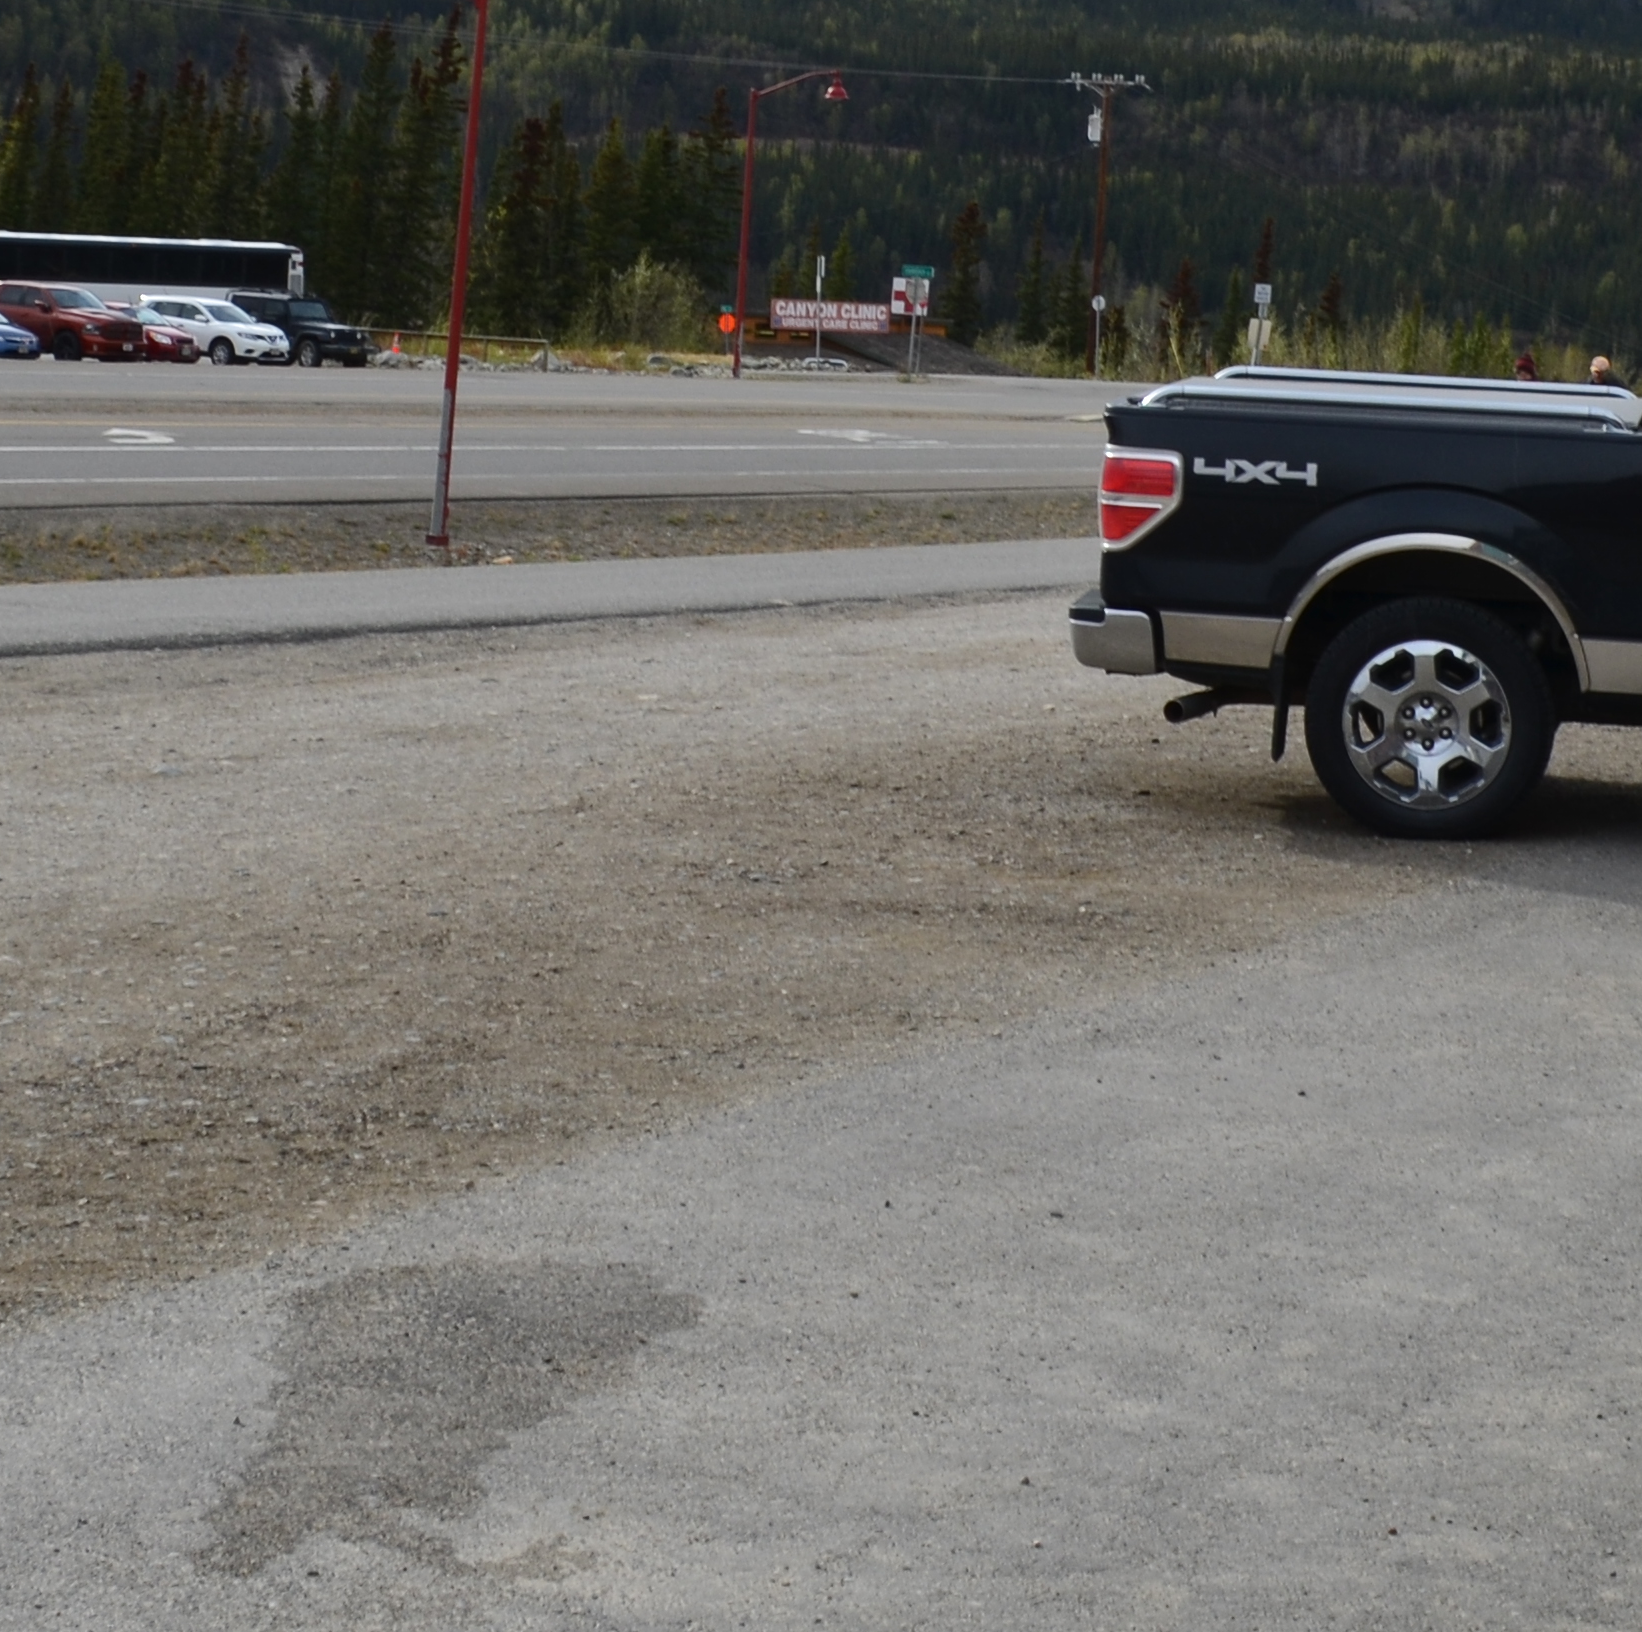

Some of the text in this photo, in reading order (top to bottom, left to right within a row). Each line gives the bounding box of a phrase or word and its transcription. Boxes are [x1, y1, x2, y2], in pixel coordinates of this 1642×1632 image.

[776, 300, 887, 320] CANYON CLINIC
[822, 319, 848, 329] CARE
[849, 321, 878, 331] CLINIC
